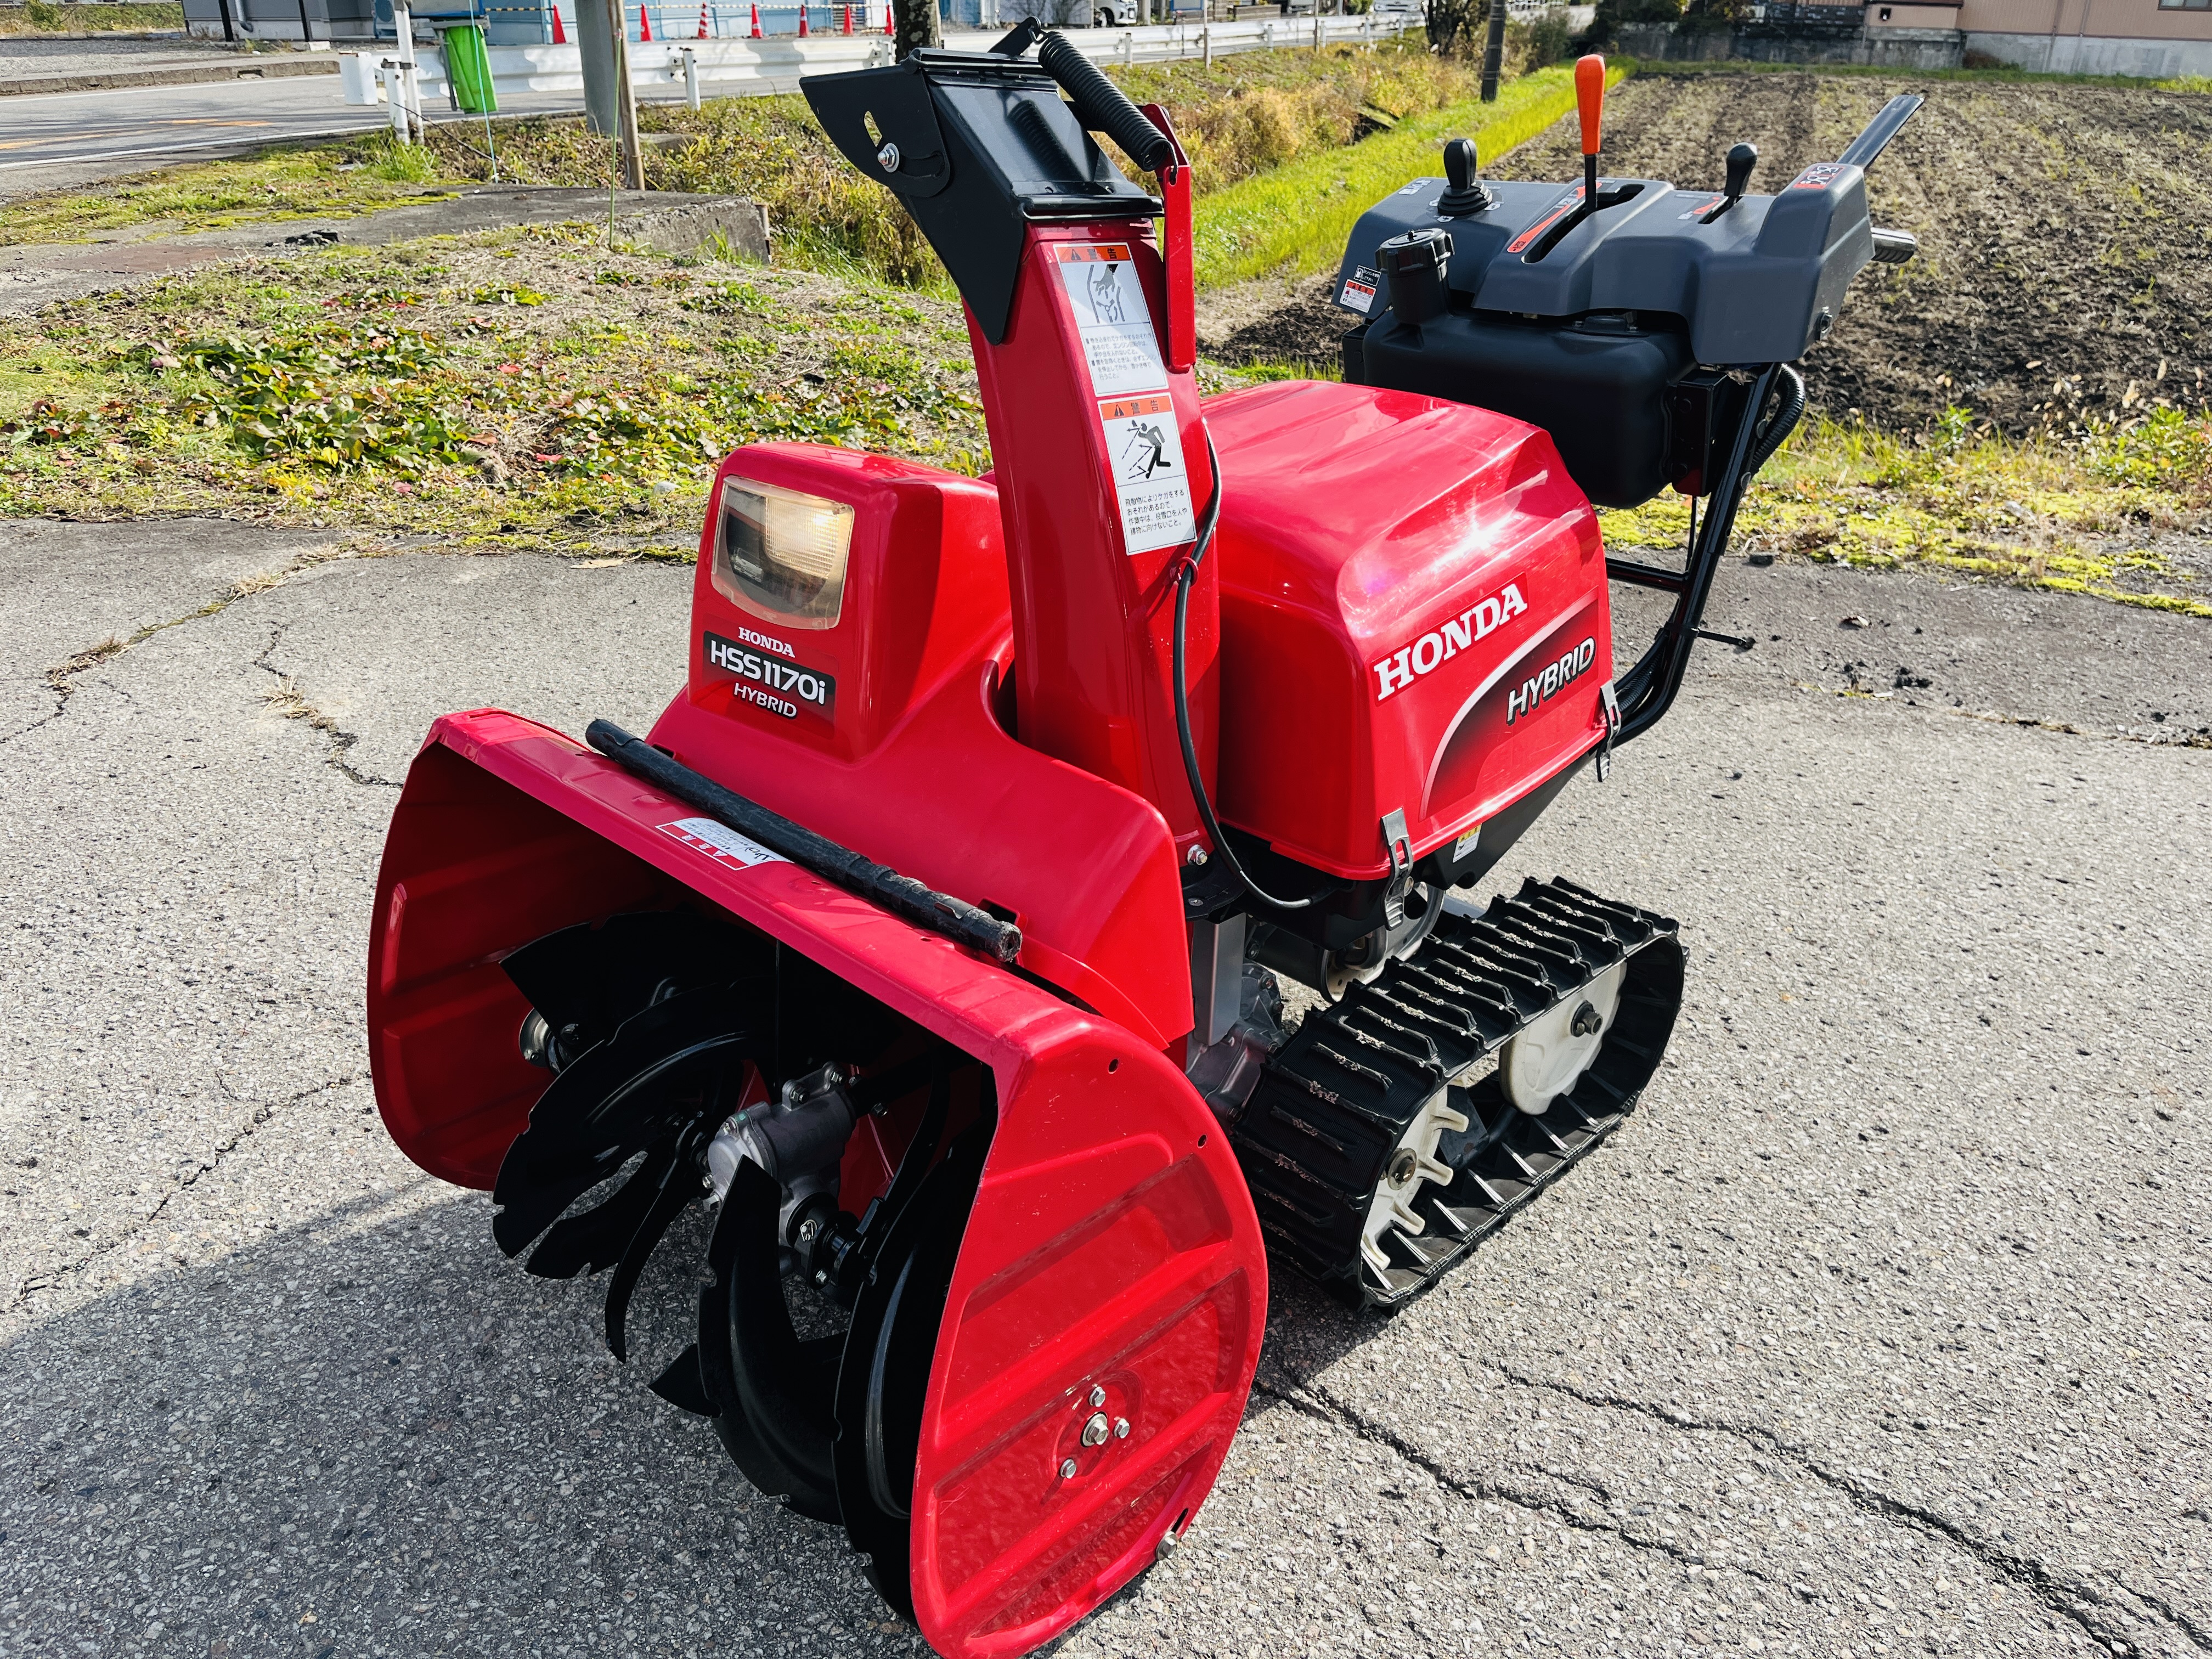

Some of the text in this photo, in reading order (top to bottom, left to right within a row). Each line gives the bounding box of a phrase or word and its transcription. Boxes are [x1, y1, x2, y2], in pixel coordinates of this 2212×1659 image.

[710, 640, 826, 705] HSS1170i
[738, 627, 795, 658] HONDA
[1374, 583, 1527, 701] HONDA
[734, 682, 797, 718] HYBRID
[1507, 637, 1595, 724] HYBRID
